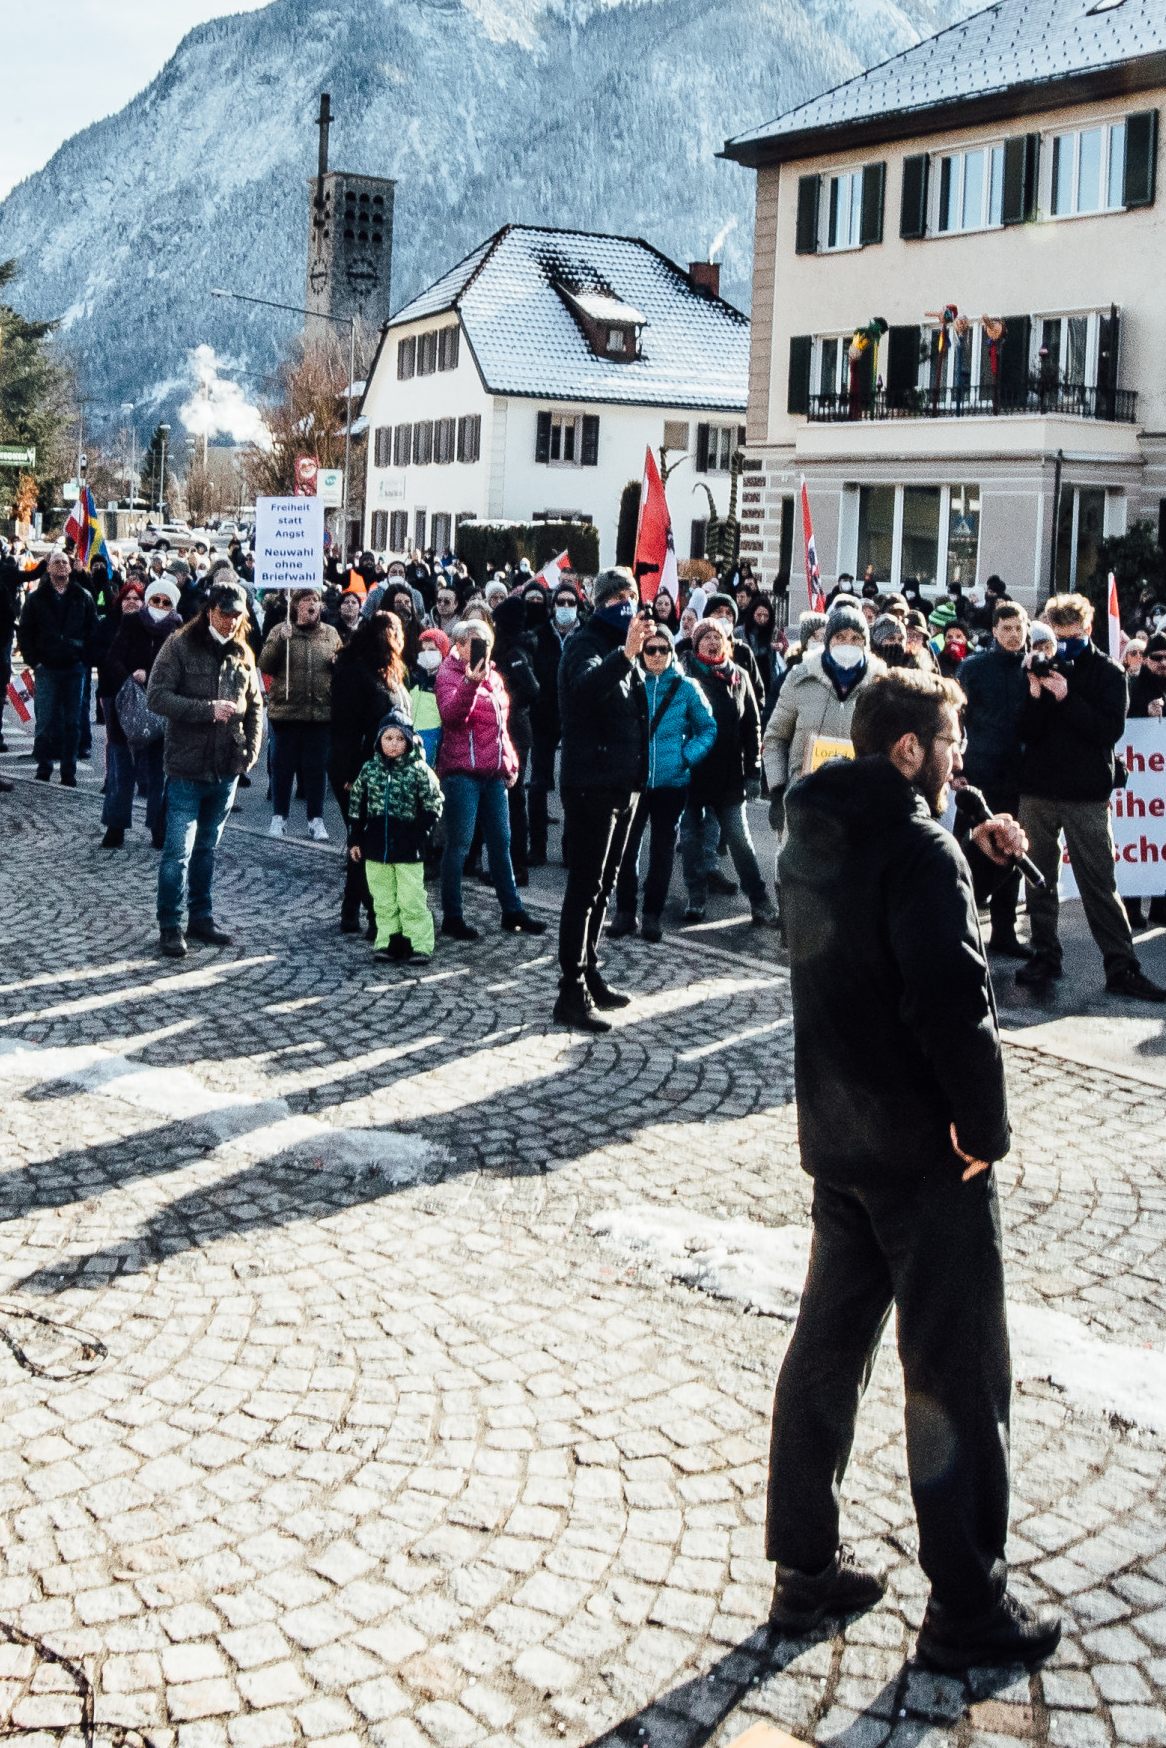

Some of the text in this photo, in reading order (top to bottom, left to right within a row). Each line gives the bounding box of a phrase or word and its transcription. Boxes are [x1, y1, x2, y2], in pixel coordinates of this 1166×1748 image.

[271, 503, 310, 511] Freiheit
[275, 530, 304, 539] Angst
[264, 548, 313, 556] Neuwahl
[275, 560, 302, 568] ohne
[262, 572, 315, 580] Briefwahl
